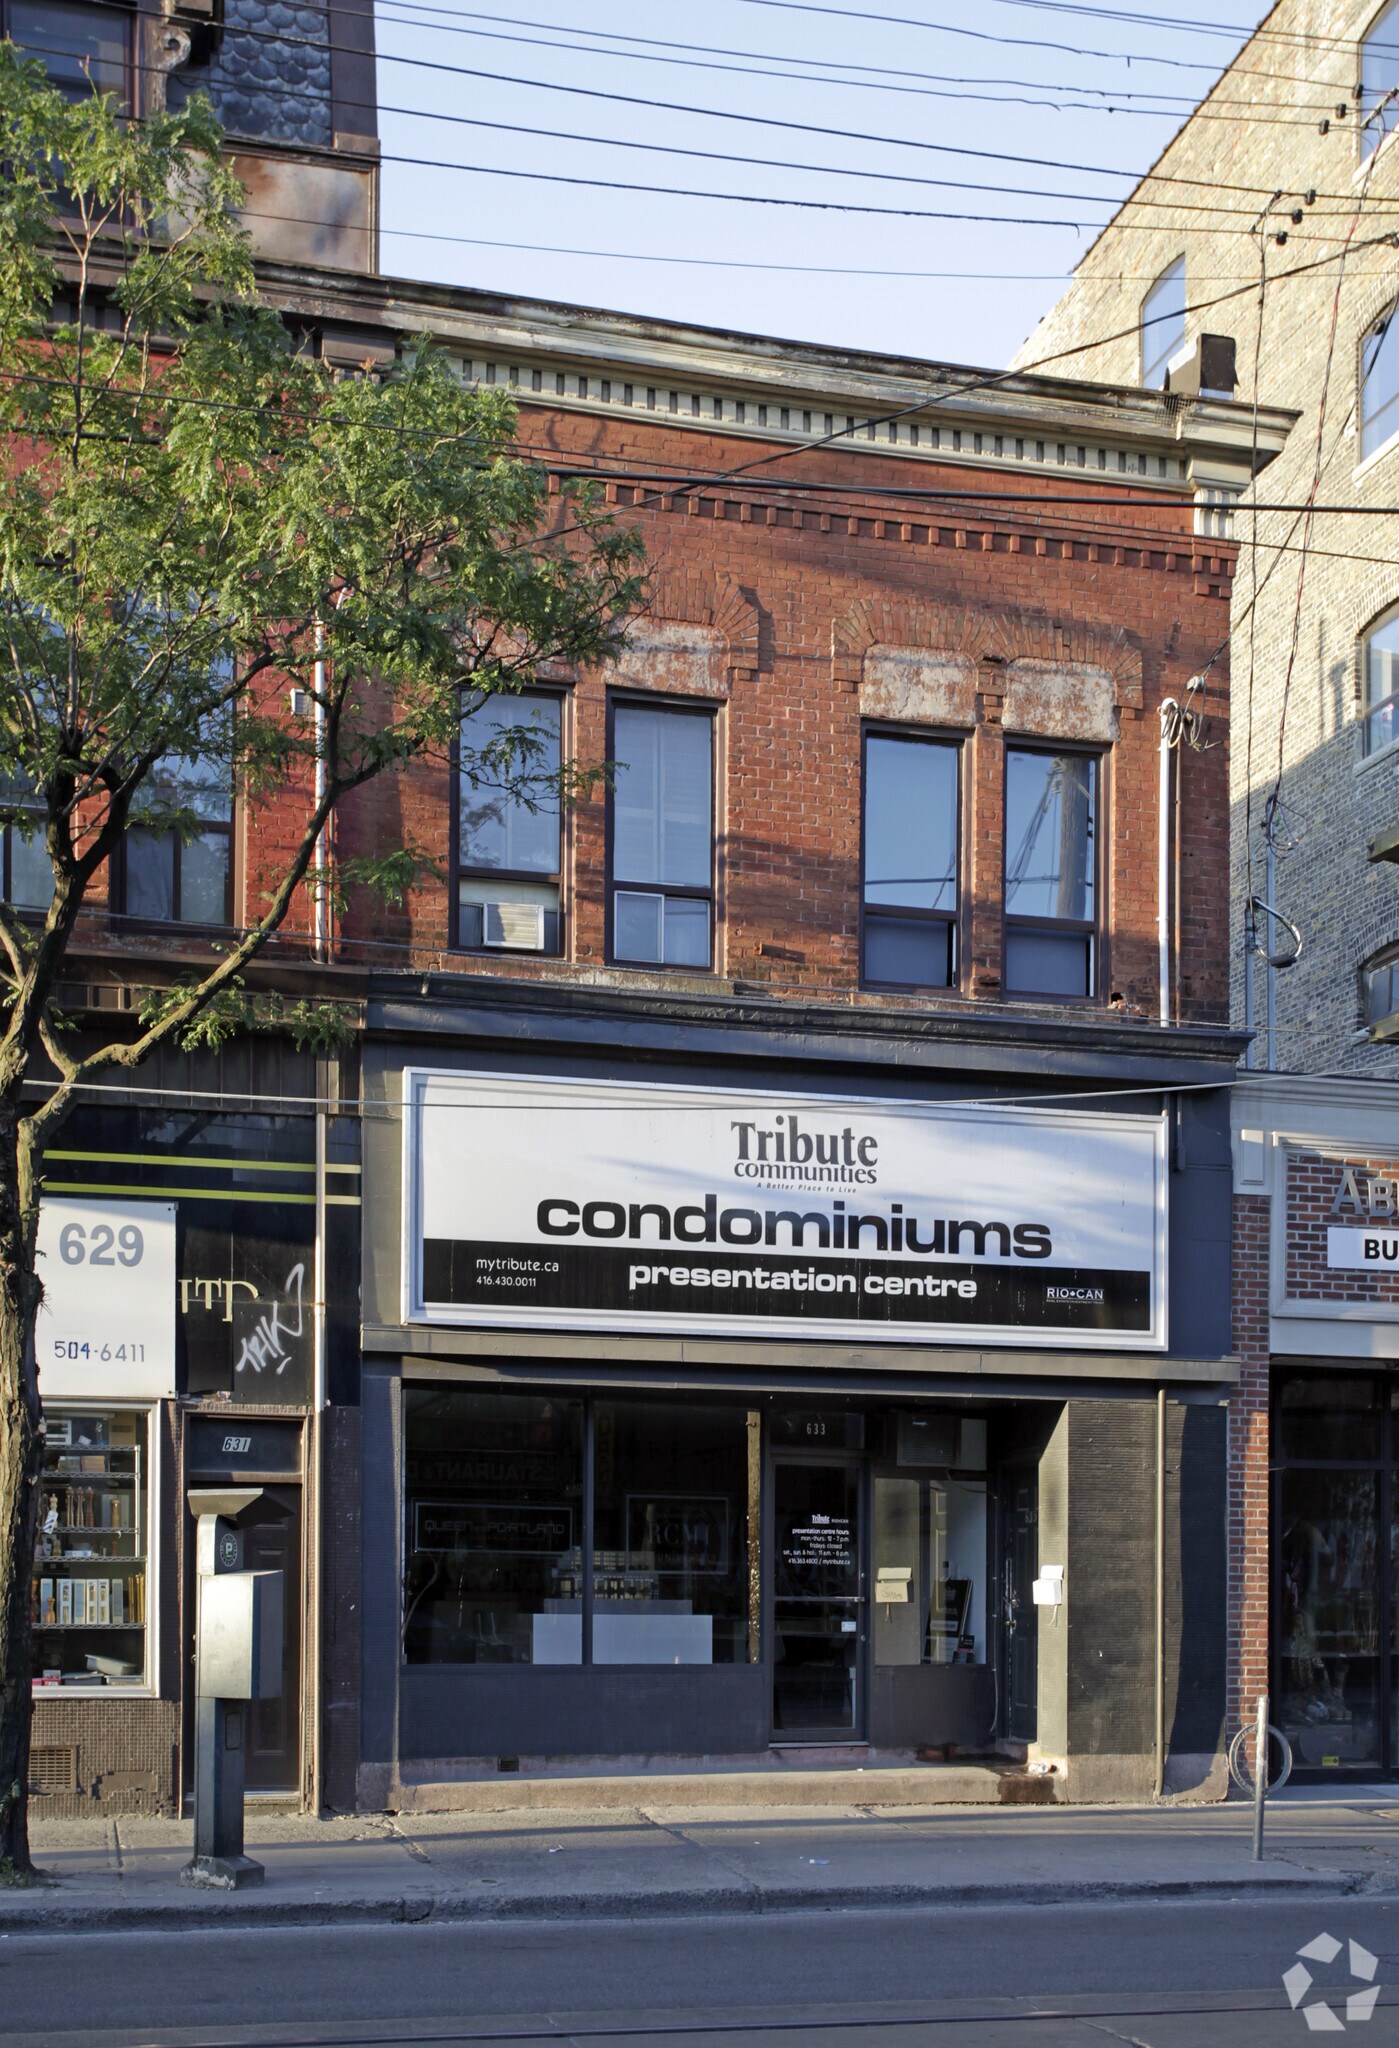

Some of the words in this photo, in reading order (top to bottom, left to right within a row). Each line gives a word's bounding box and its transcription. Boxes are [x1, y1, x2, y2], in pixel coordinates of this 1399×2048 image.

[731, 1115, 878, 1167] Tribute
[734, 1162, 877, 1184] communities
[766, 1182, 794, 1190] Better
[798, 1184, 822, 1192] Place
[839, 1186, 857, 1194] Live
[537, 1194, 1052, 1259] condominiums
[60, 1222, 144, 1267] 629
[476, 1258, 560, 1272] mytribute.ca
[476, 1276, 536, 1287] 416.430.0011
[629, 1265, 856, 1293] presentation
[864, 1274, 978, 1298] centre
[54, 1341, 144, 1362] 504-6411
[806, 1422, 826, 1435] 633
[224, 1438, 248, 1451] 631
[812, 1514, 830, 1523] Tribute
